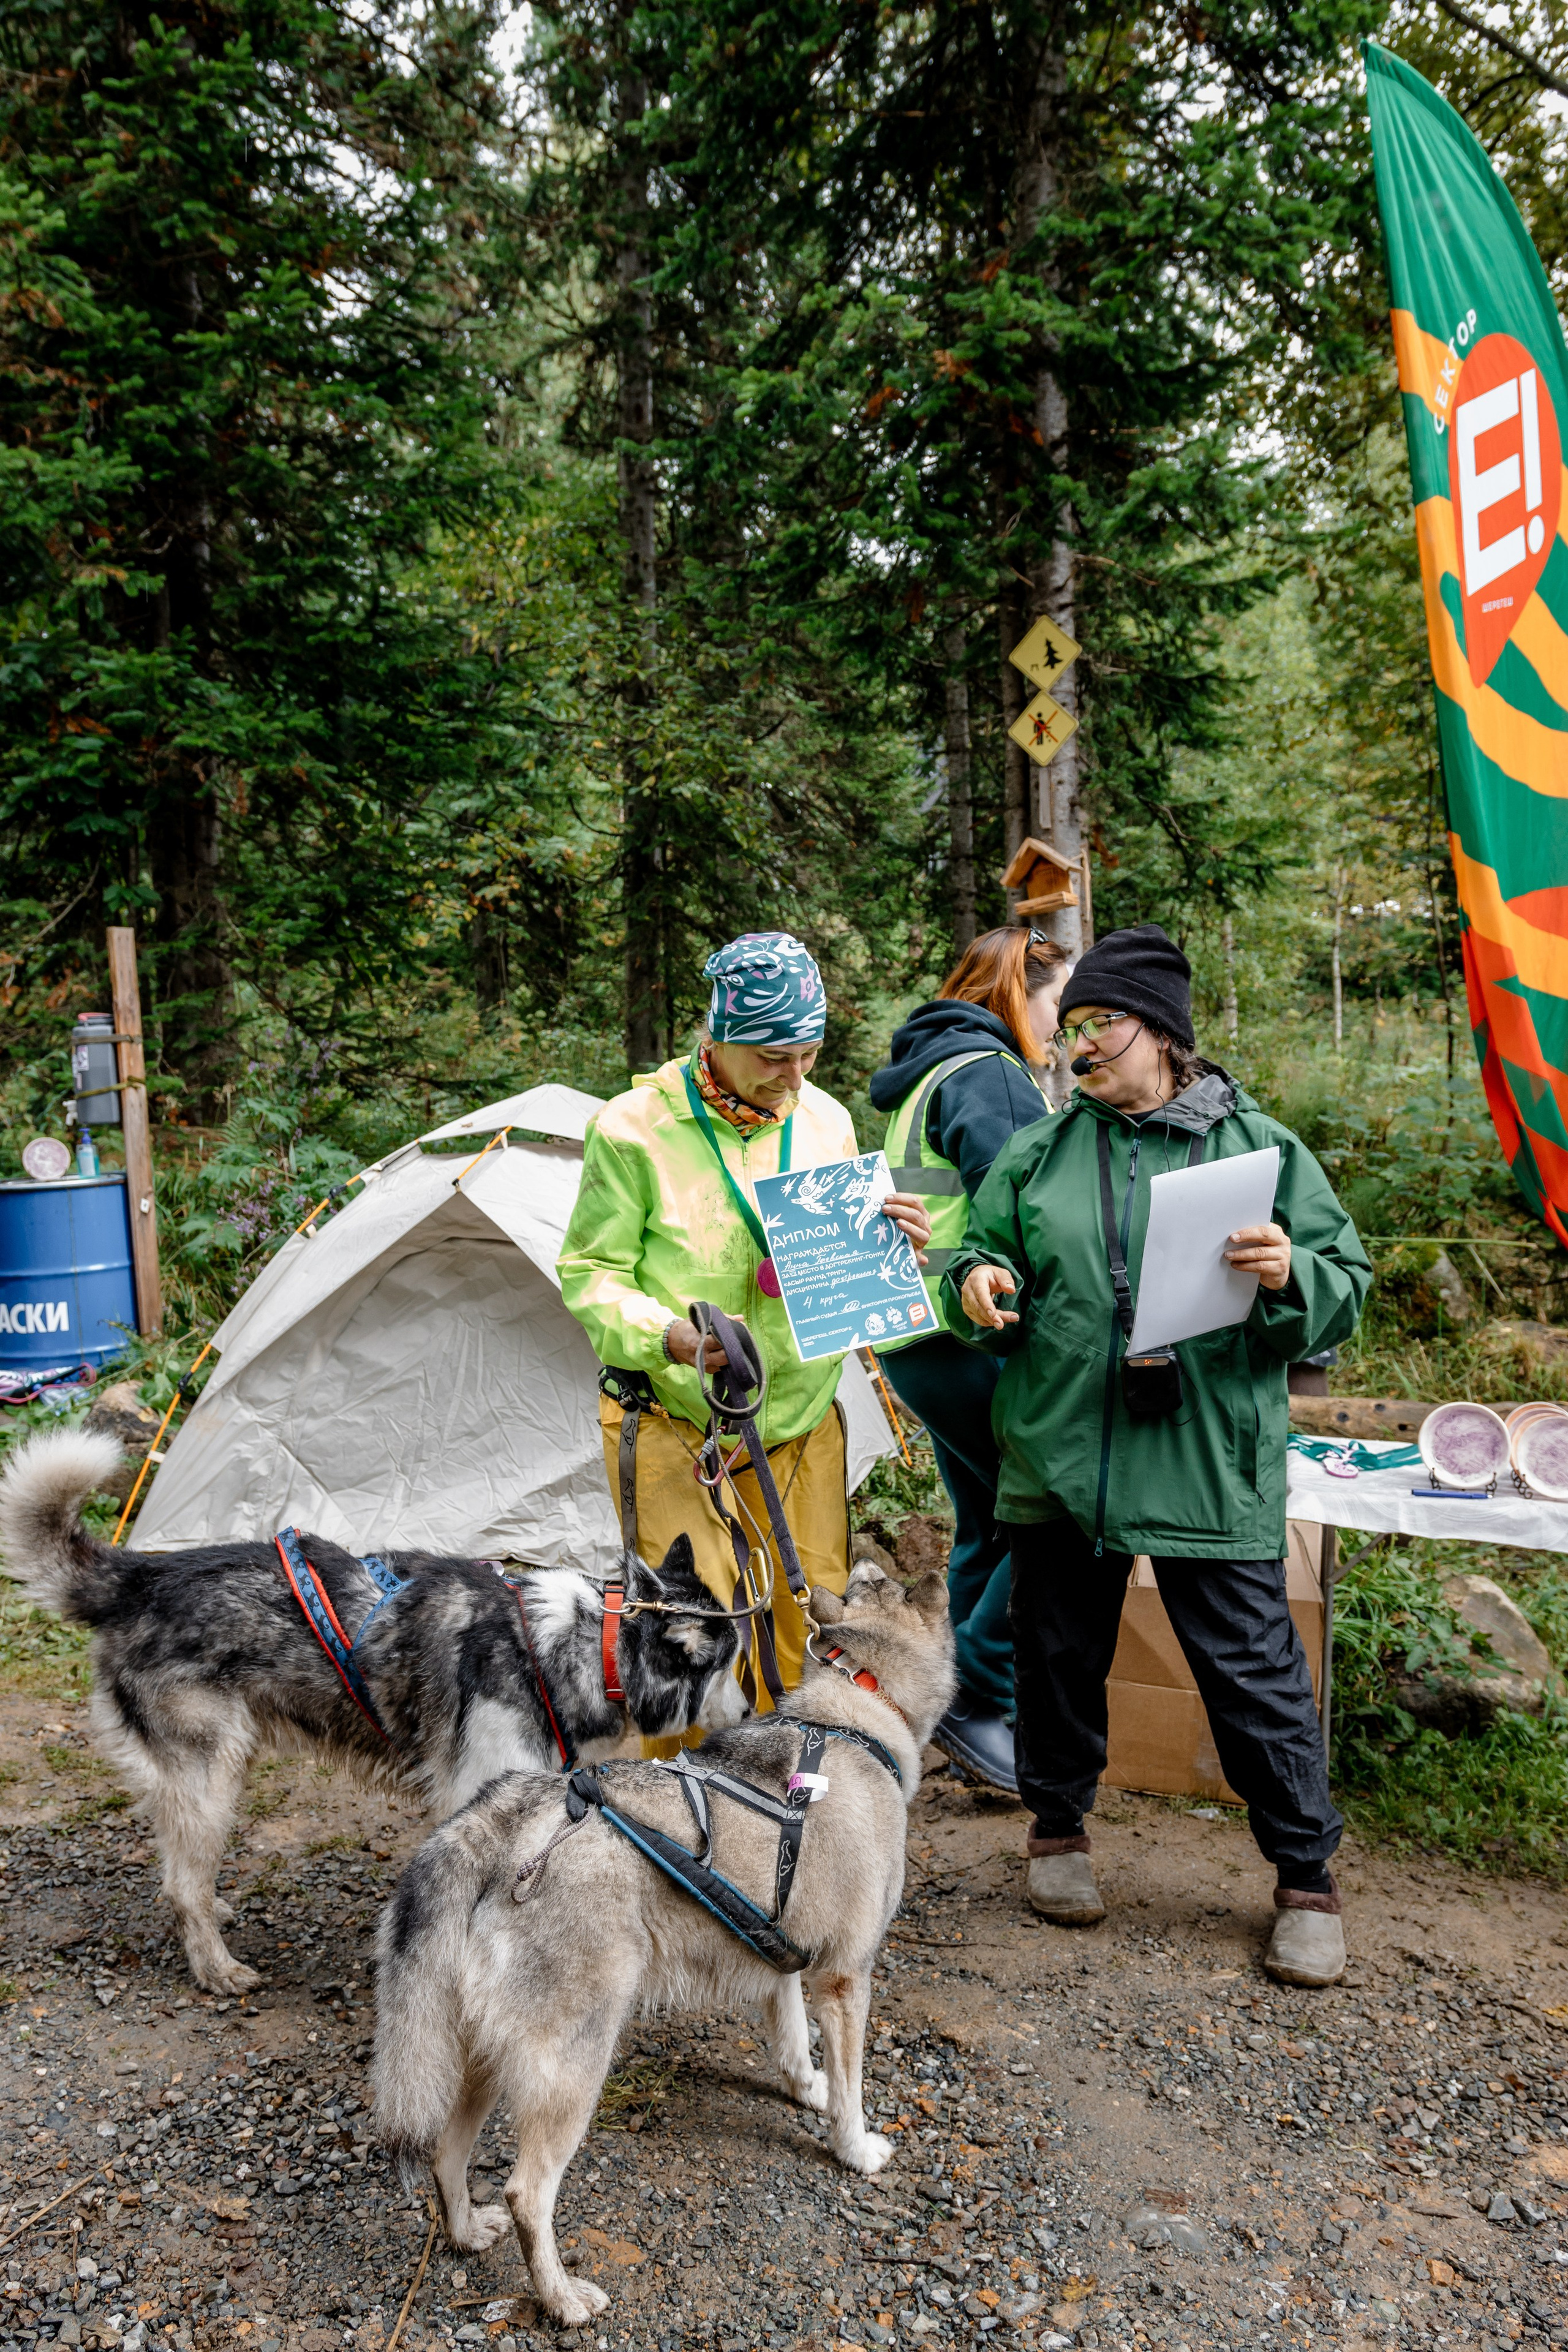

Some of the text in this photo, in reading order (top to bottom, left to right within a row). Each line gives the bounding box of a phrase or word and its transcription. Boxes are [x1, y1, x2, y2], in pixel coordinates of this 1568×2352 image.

[1433, 308, 1477, 435] СЕКТОР
[772, 1222, 840, 1250] ДИПЛОМ
[776, 1241, 847, 1263] НАГРАЖДАЕТСЯ
[797, 1266, 820, 1276] МЕСТО
[825, 1250, 886, 1270] ДОГТРЕКИНГ-ГОНКЕ
[783, 1261, 810, 1271] Анна
[783, 1268, 846, 1287] «АСЫР РАУНД ТРИП»
[786, 1281, 830, 1297] ДИСЦИПЛИНА
[796, 1314, 820, 1325] ГЛАВНЫЙ
[820, 1311, 838, 1319] СУДЬЯ
[861, 1298, 888, 1310] ВИКТОРИЯ
[803, 1295, 813, 1309] 4
[820, 1292, 849, 1307] круга
